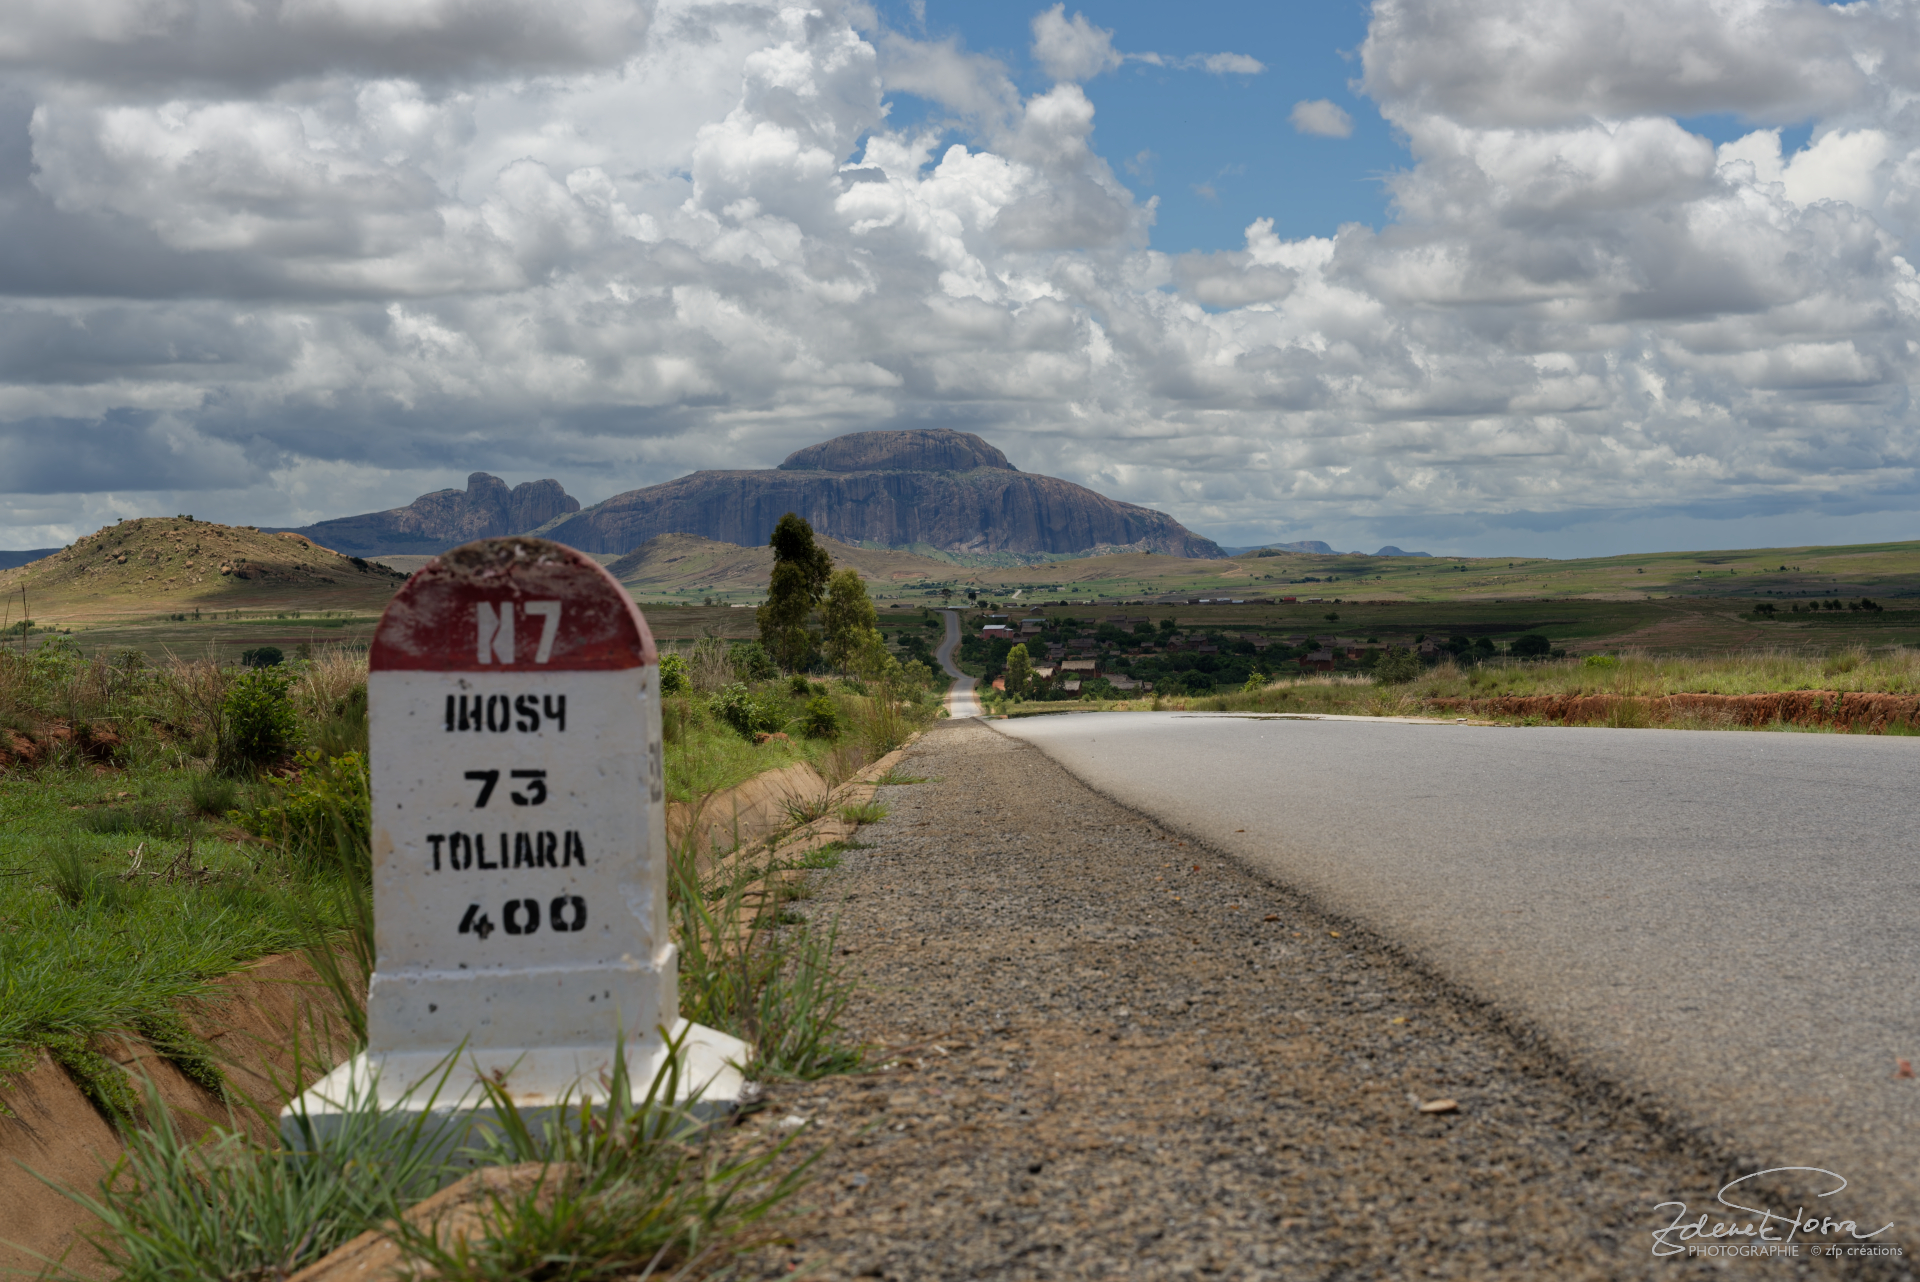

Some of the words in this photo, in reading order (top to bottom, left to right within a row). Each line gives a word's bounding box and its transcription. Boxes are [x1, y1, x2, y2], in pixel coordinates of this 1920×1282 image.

[476, 601, 562, 665] N7
[445, 695, 567, 732] IHOSY
[464, 769, 548, 809] 73
[426, 831, 587, 871] TOLIARA
[458, 896, 588, 939] 400
